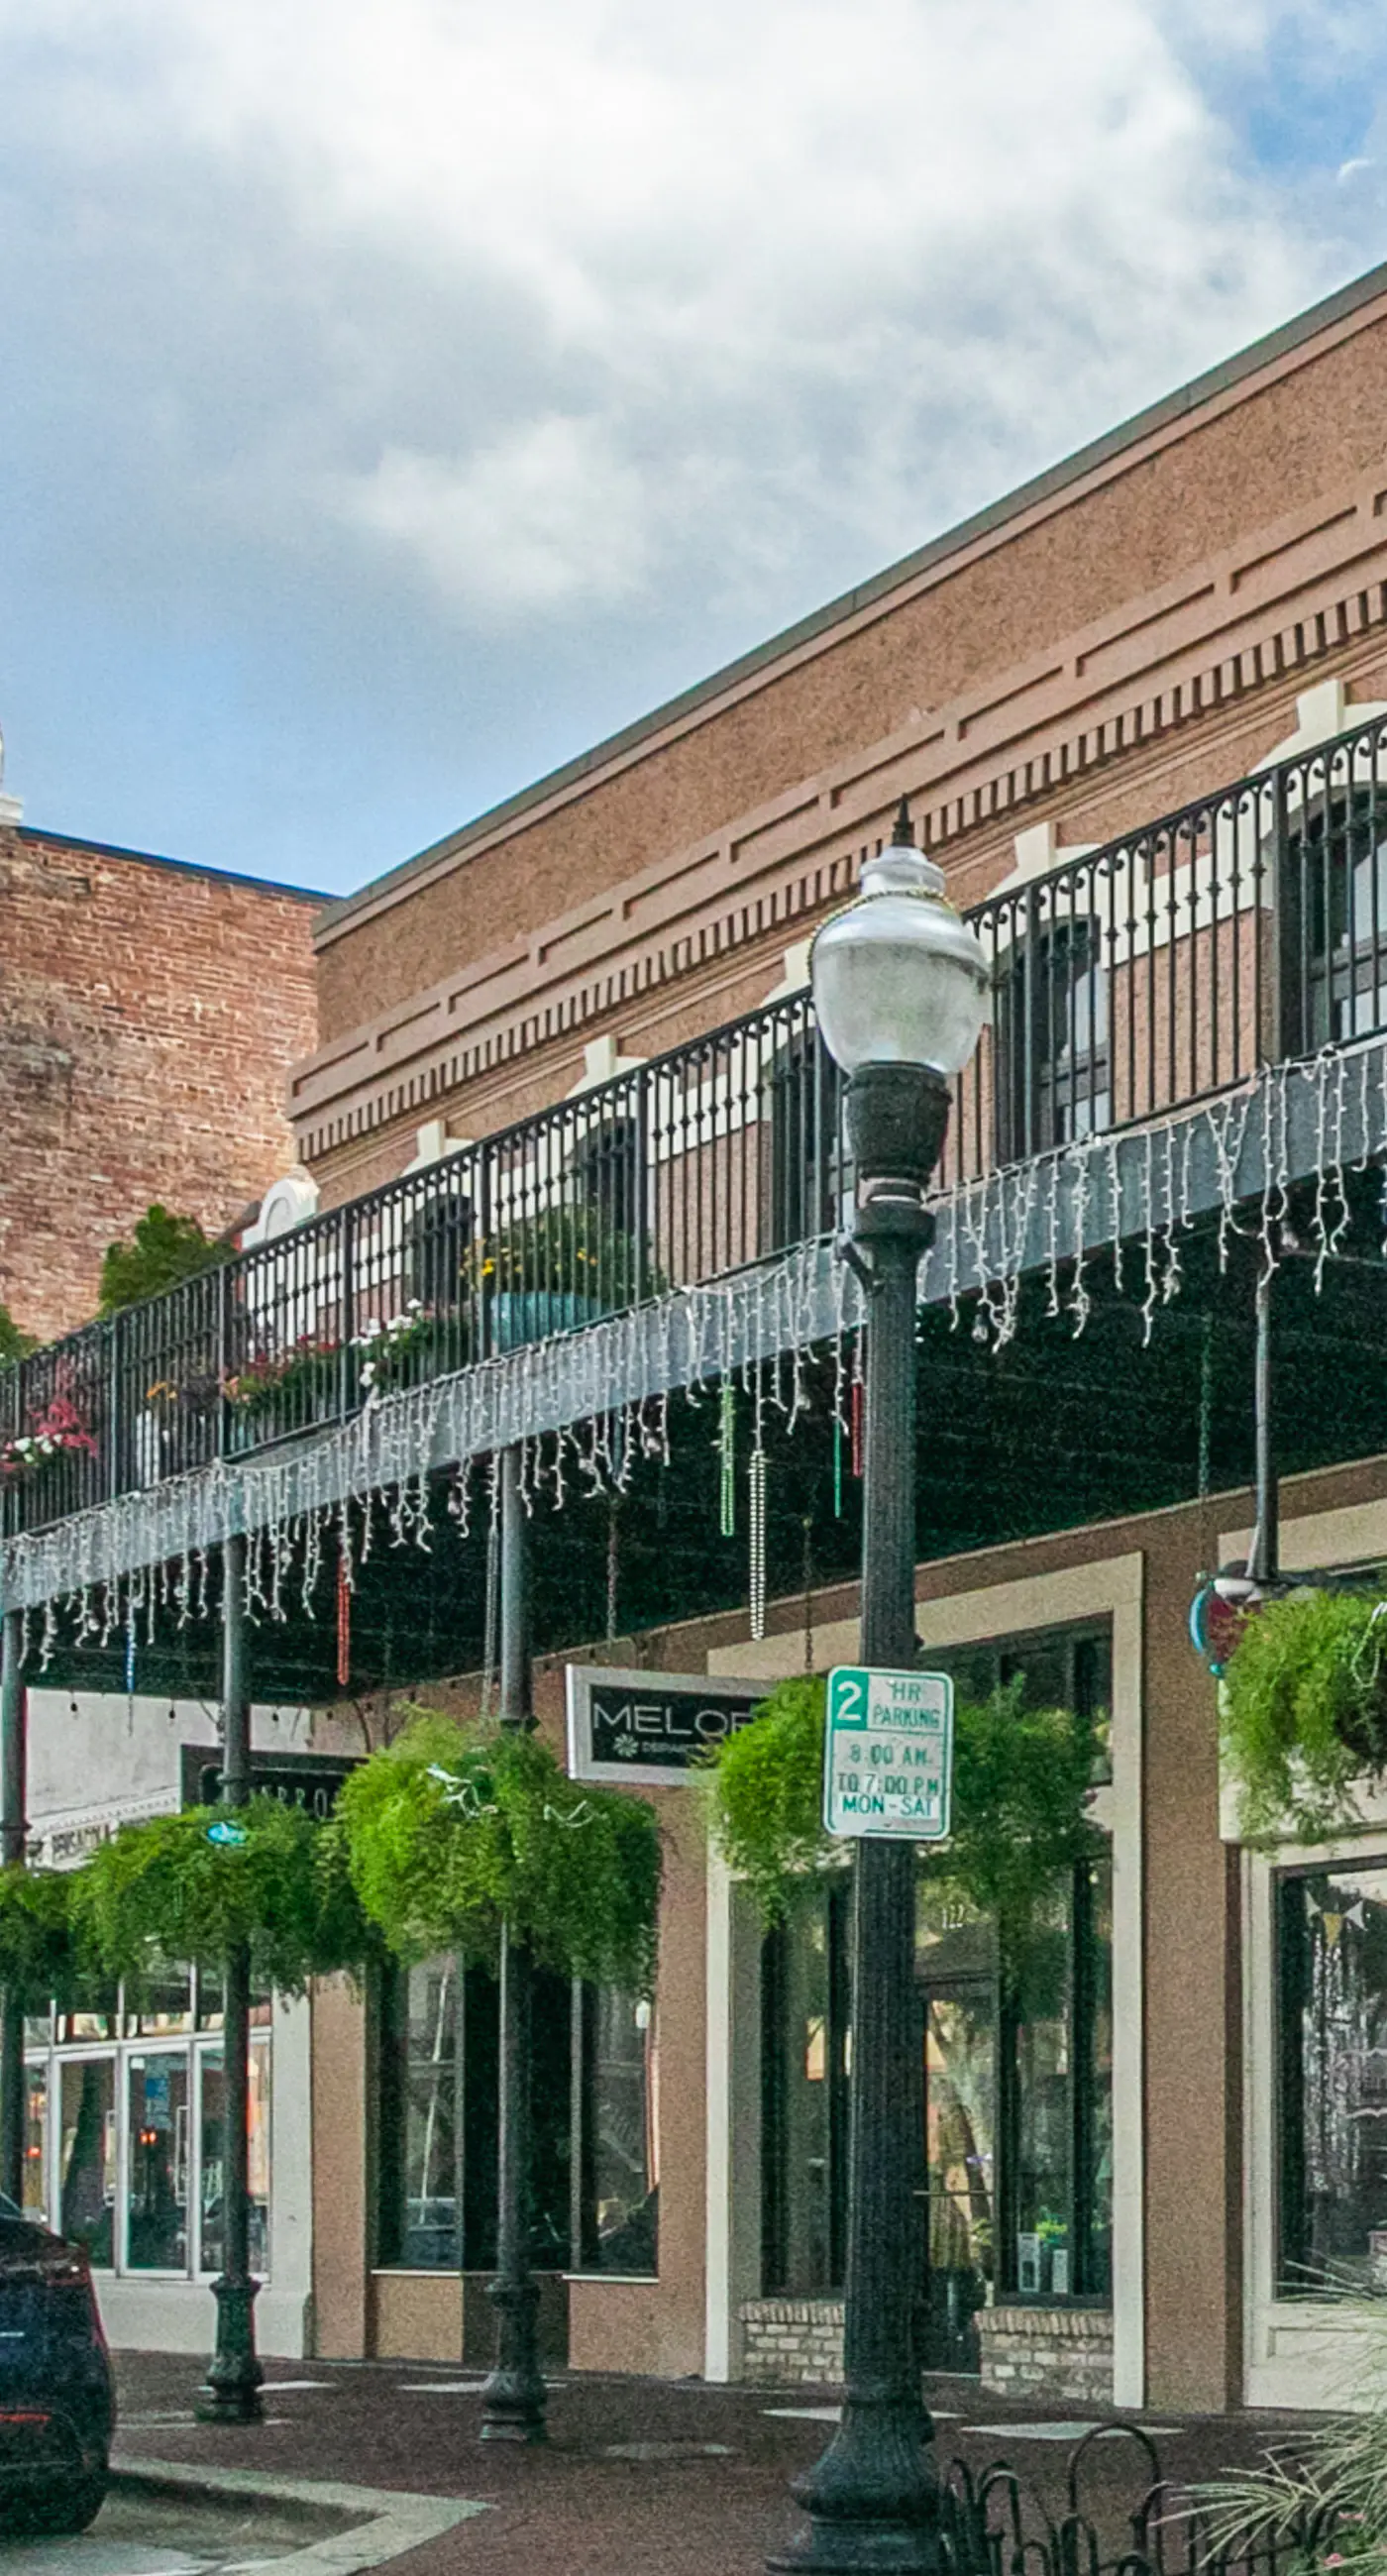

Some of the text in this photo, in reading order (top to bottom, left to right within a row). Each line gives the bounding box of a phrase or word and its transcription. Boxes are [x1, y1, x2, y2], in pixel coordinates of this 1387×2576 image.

[836, 1680, 921, 1721] 2 HR
[873, 1705, 941, 1728] PARKING
[836, 1772, 859, 1793] TO
[864, 1773, 907, 1796] 7:00
